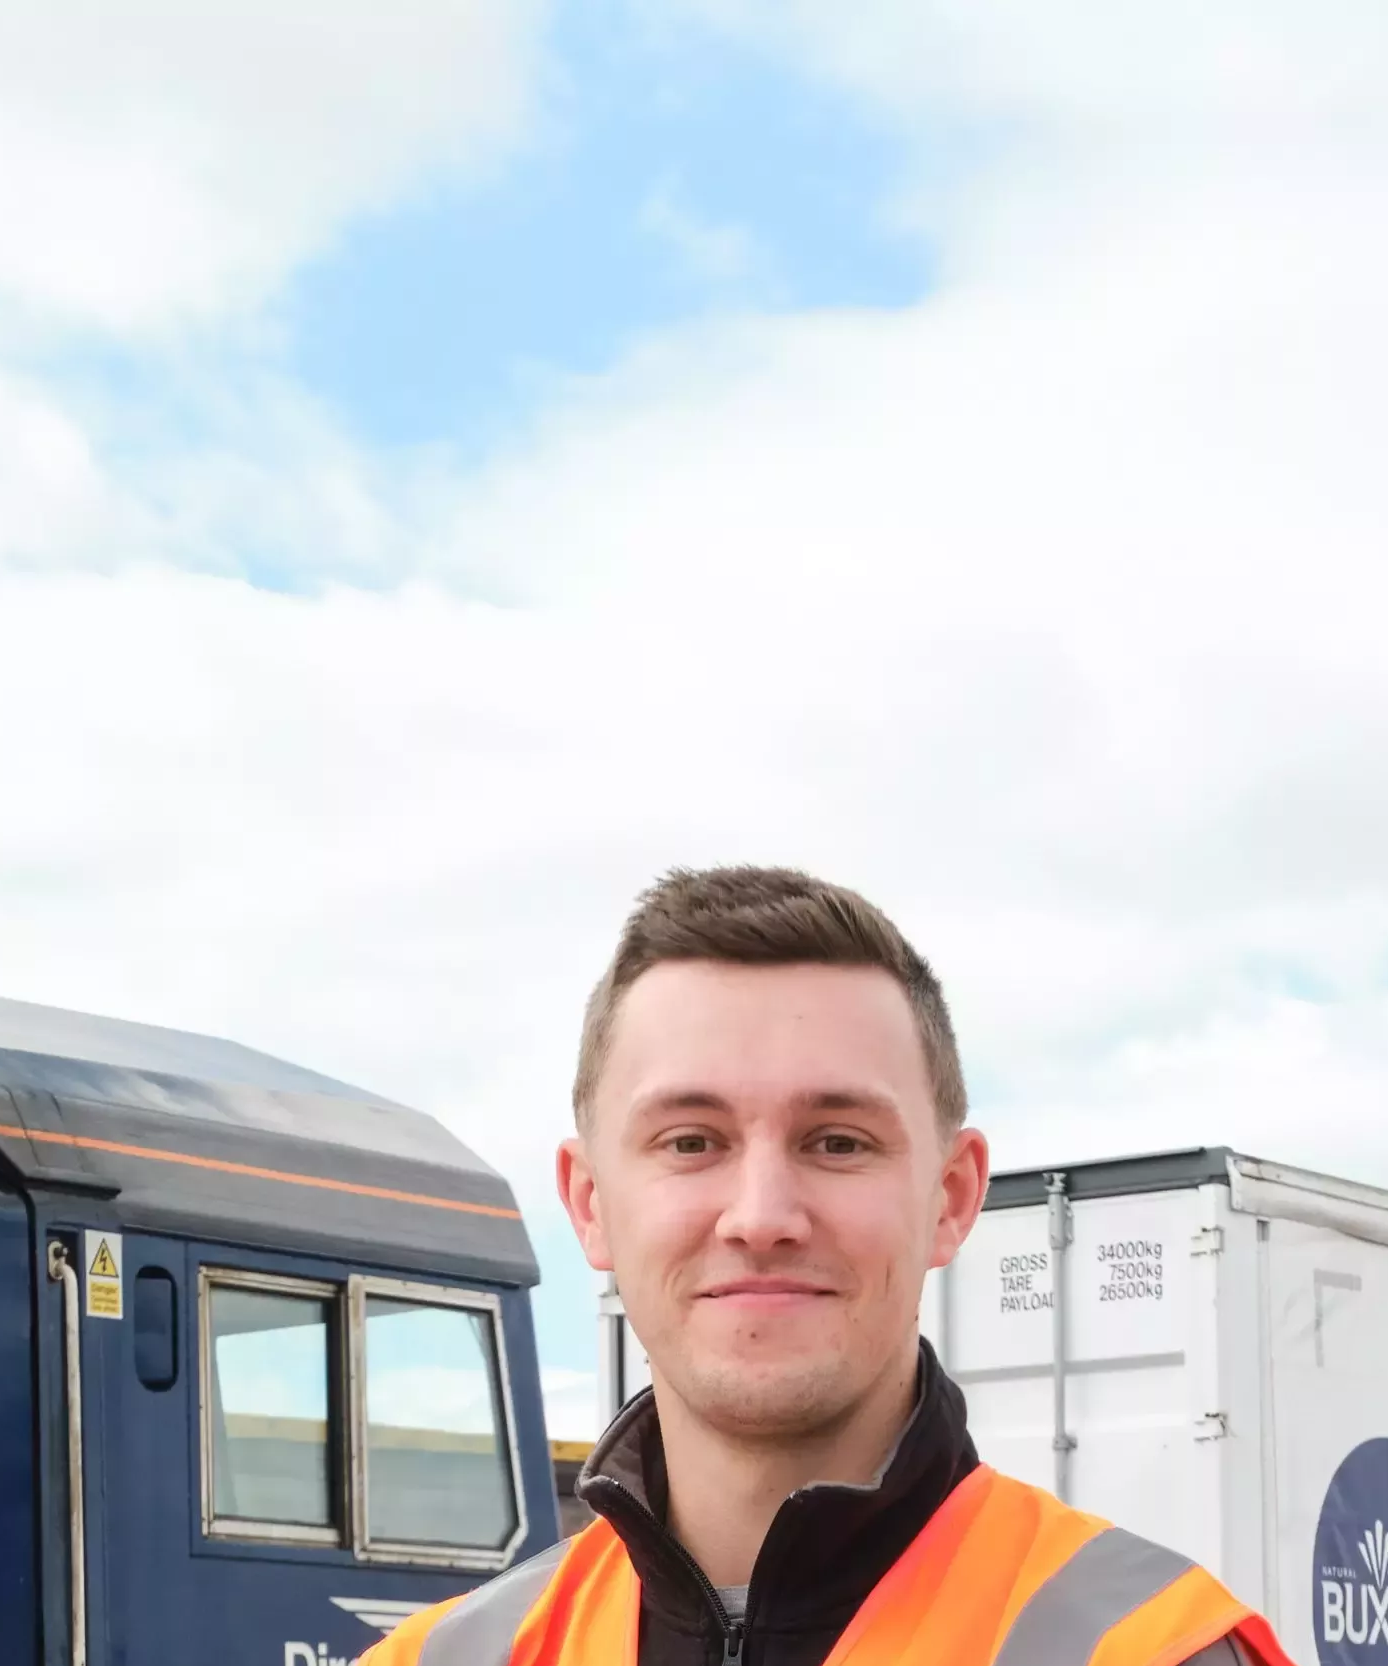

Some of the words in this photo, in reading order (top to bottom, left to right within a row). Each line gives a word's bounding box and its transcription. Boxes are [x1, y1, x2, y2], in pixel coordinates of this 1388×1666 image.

[999, 1252, 1048, 1274] GROSS
[1096, 1239, 1163, 1262] 34000kg
[999, 1273, 1033, 1293] TARE
[1109, 1260, 1163, 1281] 7500kg
[1098, 1280, 1163, 1302] 26500kg
[1322, 1566, 1357, 1579] NATURAL
